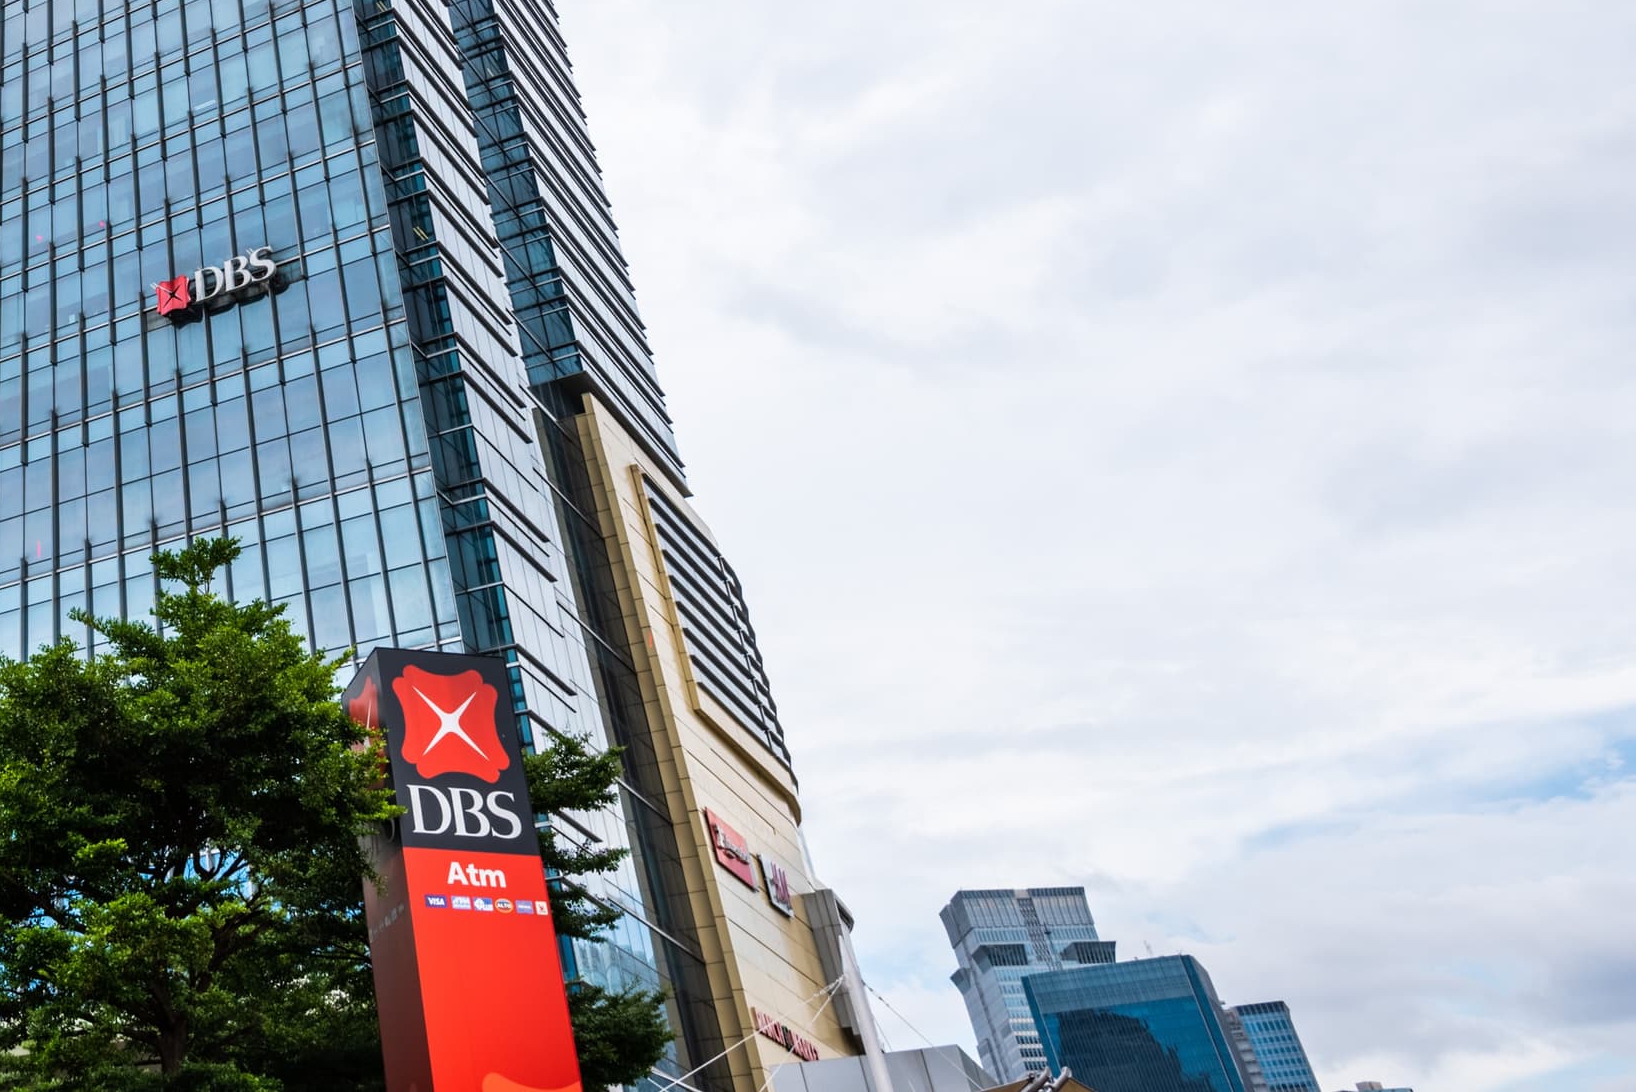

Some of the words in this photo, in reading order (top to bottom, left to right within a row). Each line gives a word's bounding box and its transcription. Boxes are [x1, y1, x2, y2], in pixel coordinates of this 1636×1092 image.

[195, 245, 277, 302] DBS
[406, 784, 522, 839] DBS
[447, 861, 507, 888] Atm
[428, 896, 445, 906] VISA
